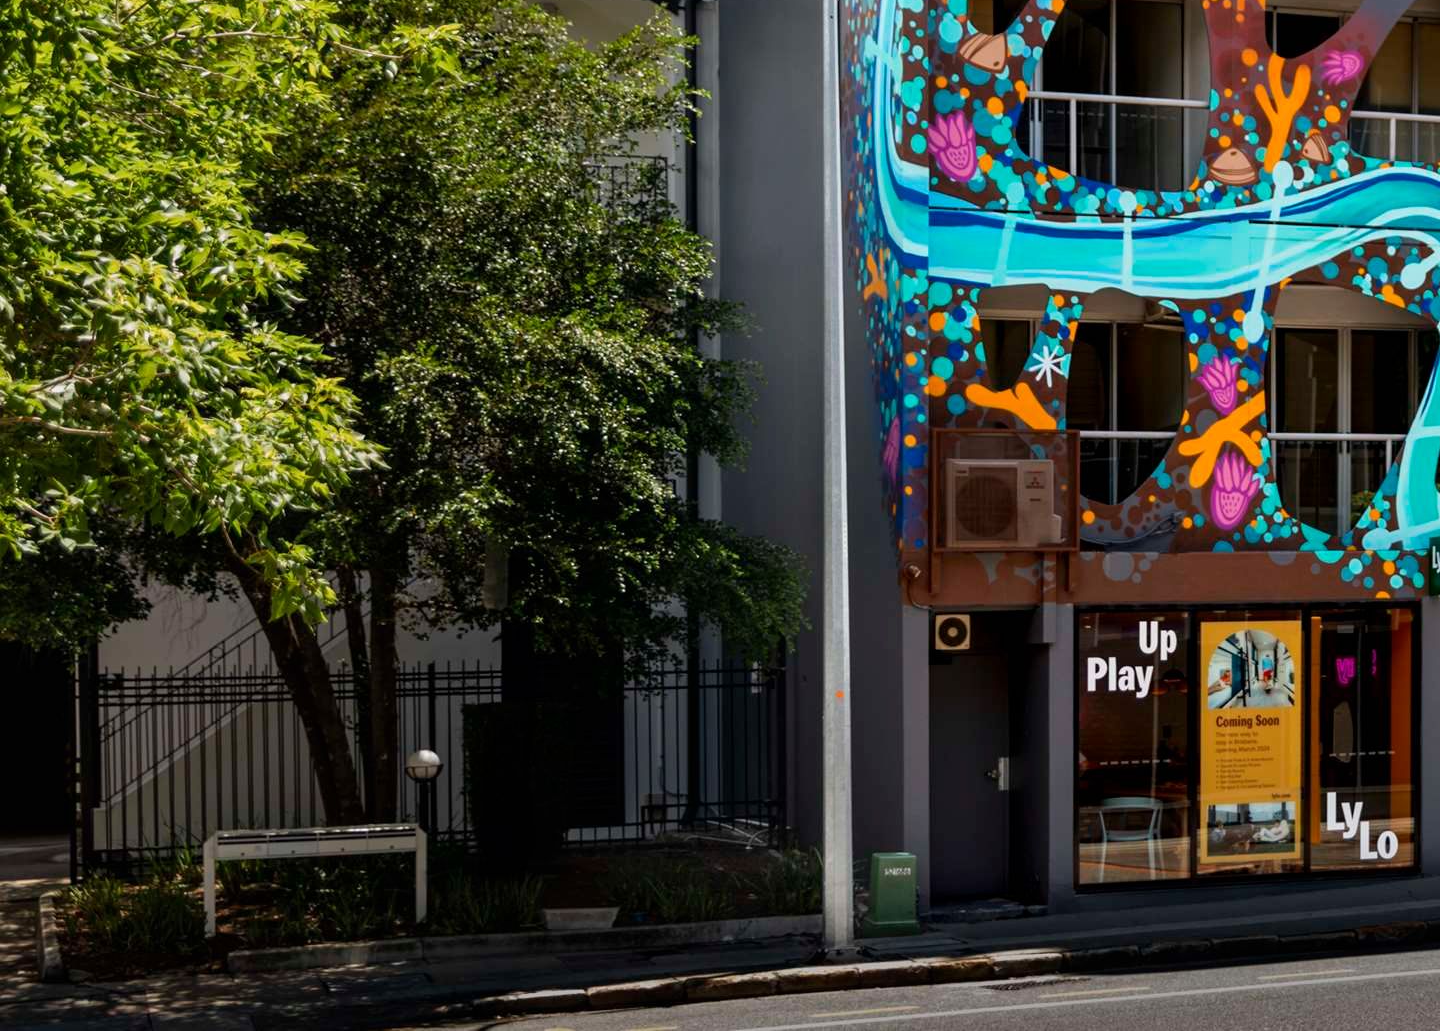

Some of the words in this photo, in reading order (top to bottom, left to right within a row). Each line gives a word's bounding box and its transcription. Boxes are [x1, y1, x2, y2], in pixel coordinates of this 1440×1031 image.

[1138, 621, 1177, 661] Up
[1087, 657, 1154, 698] Play
[1216, 715, 1253, 729] Coming
[1256, 714, 1280, 726] Soon
[1326, 791, 1364, 839] Ly
[1359, 820, 1399, 860] Lo
